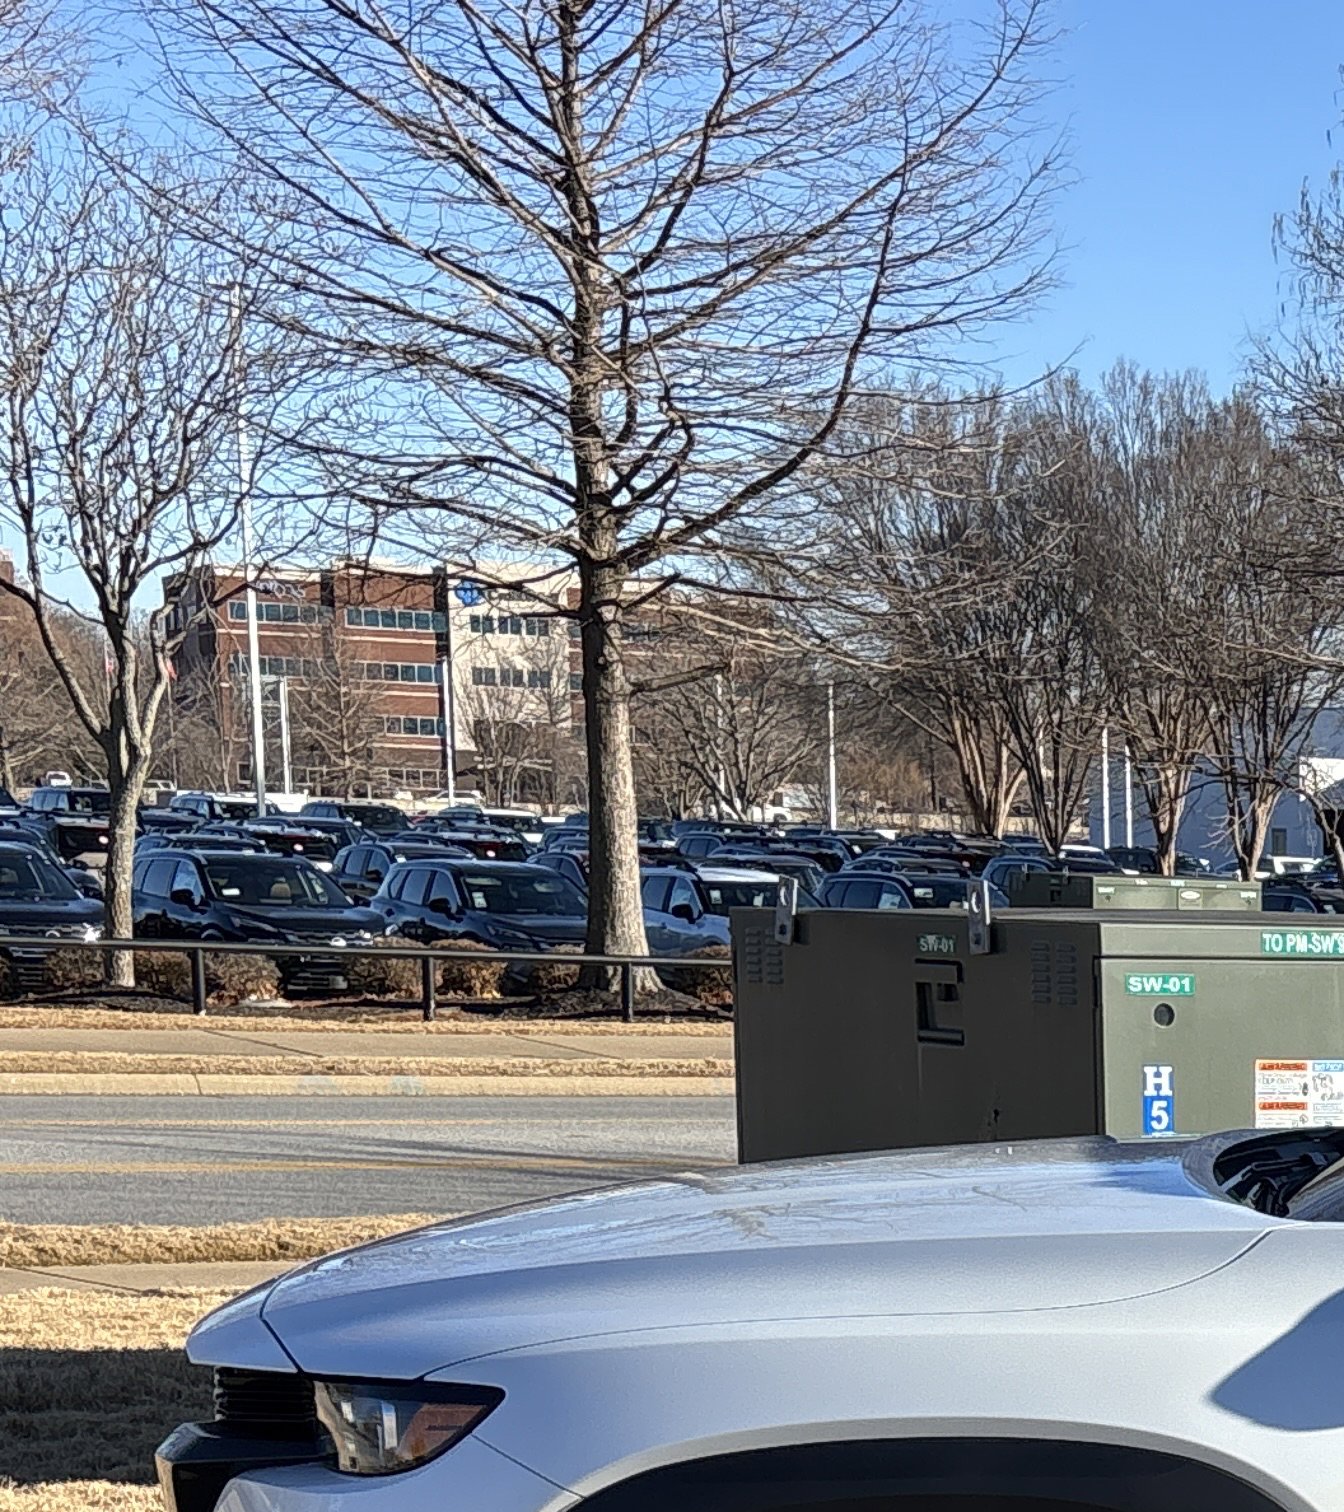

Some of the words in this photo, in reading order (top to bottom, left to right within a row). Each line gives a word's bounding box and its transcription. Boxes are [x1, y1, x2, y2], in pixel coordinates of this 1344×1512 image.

[1262, 933, 1284, 952] TO
[1127, 976, 1192, 993] SW-01
[1143, 1066, 1173, 1097] H
[1150, 1100, 1170, 1130] 5
